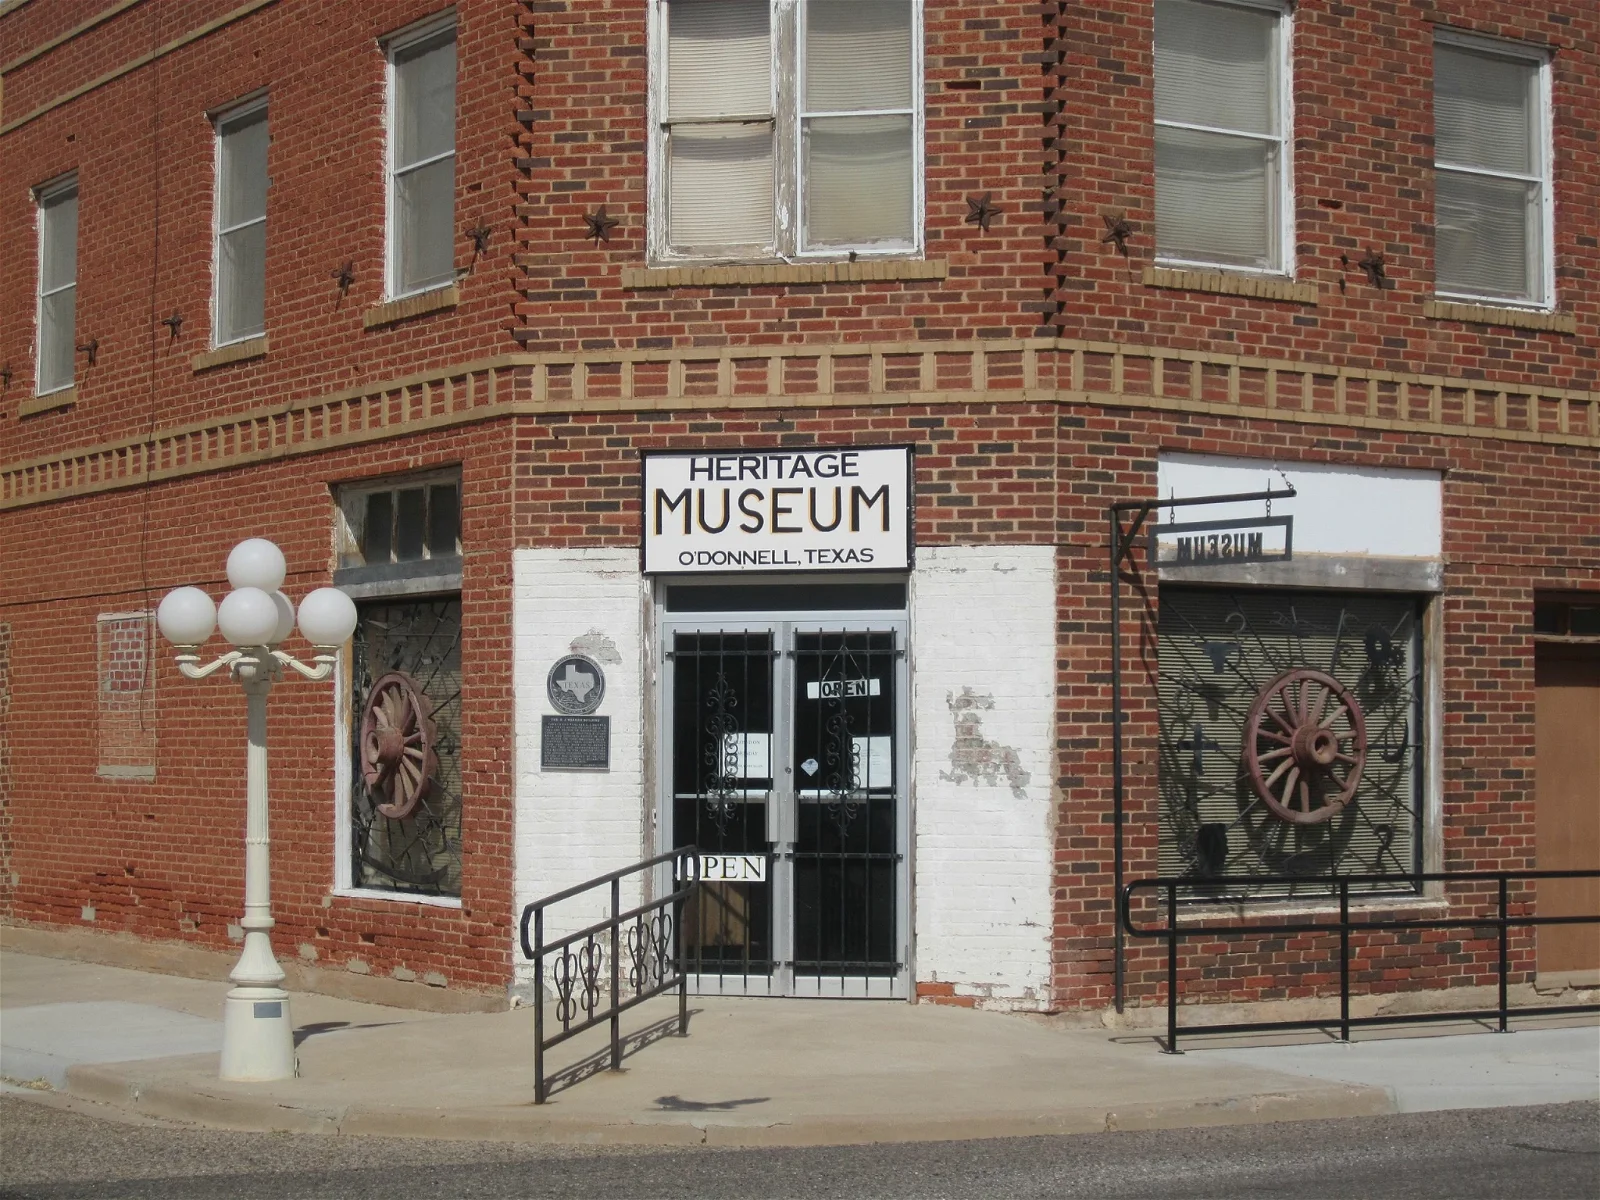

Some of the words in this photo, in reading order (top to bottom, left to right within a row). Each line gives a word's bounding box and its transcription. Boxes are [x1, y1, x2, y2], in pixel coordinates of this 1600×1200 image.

[689, 453, 860, 482] HERITAGE
[653, 484, 891, 536] MUSEUM
[678, 549, 803, 568] O'DONNELL,
[804, 547, 875, 565] TEXAS
[562, 681, 591, 690] TEXAS
[821, 680, 867, 697] OPEN
